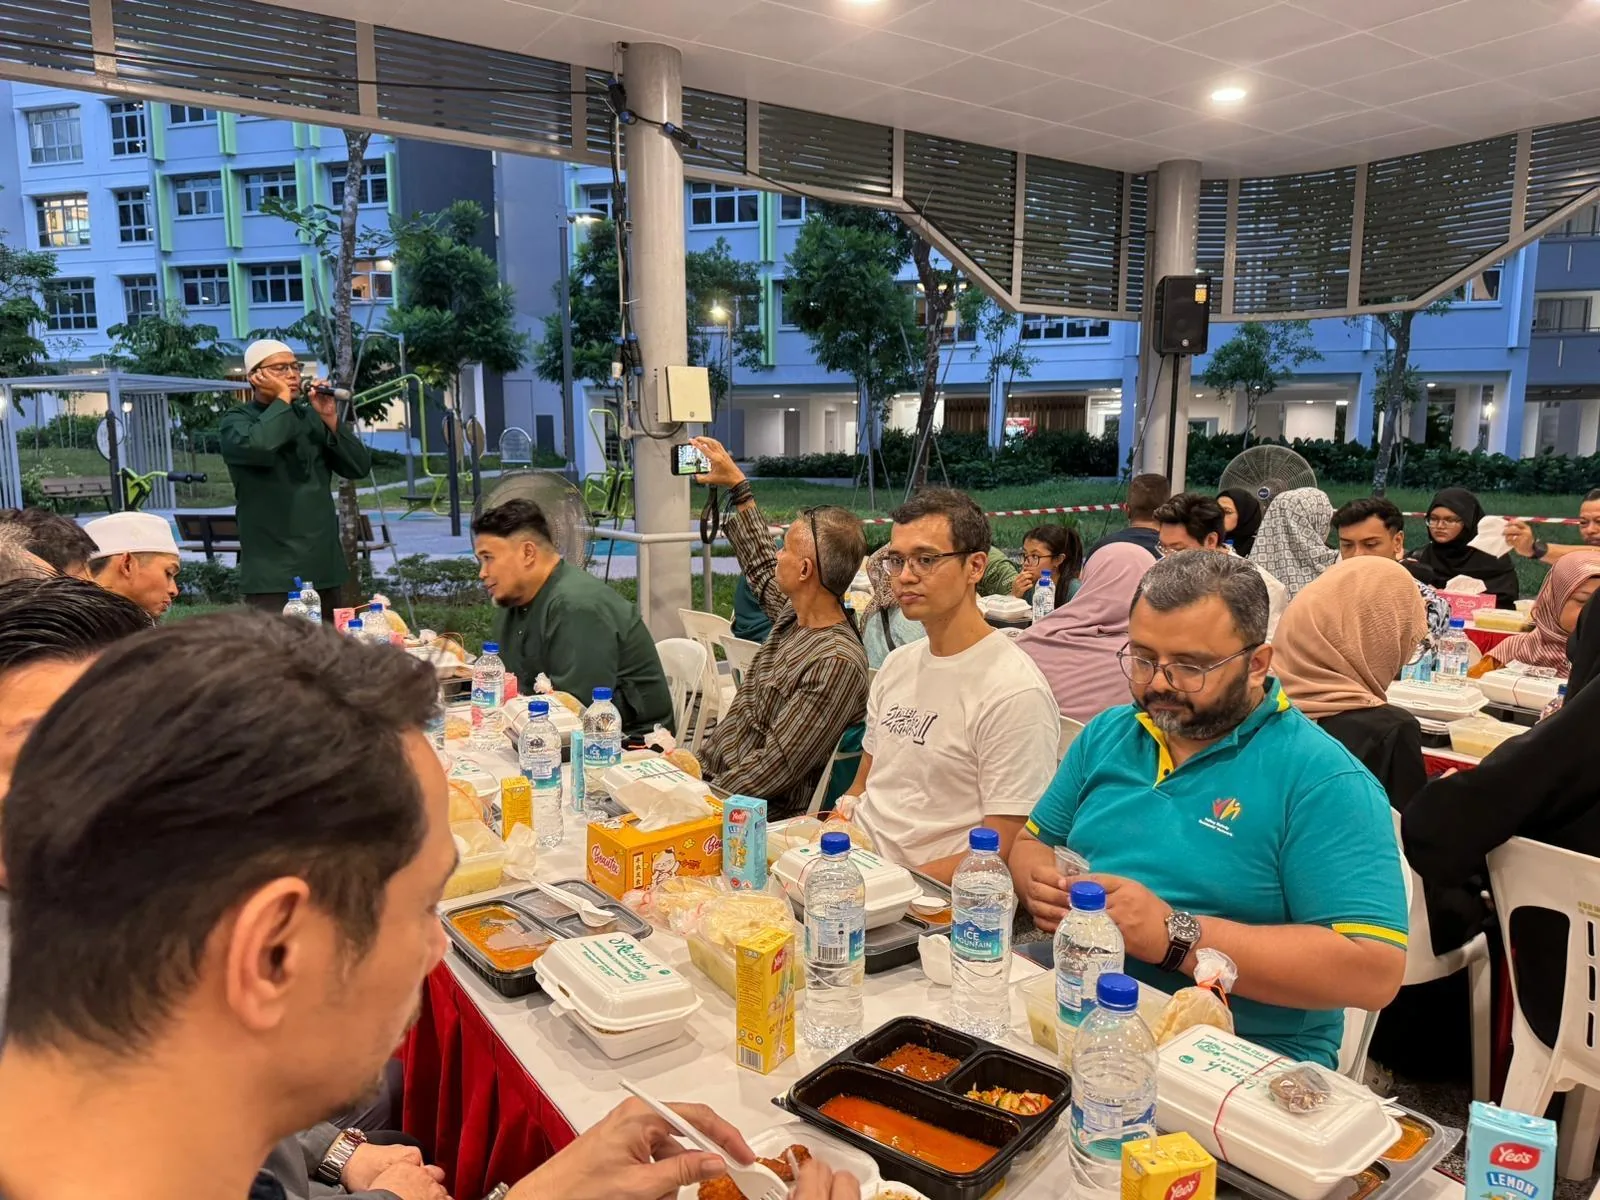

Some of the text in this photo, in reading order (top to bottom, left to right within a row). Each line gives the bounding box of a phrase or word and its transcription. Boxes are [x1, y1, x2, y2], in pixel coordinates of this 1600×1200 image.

[963, 929, 980, 941] ICE
[1498, 1146, 1532, 1165] Yeo's
[1489, 1171, 1535, 1197] LEMON
